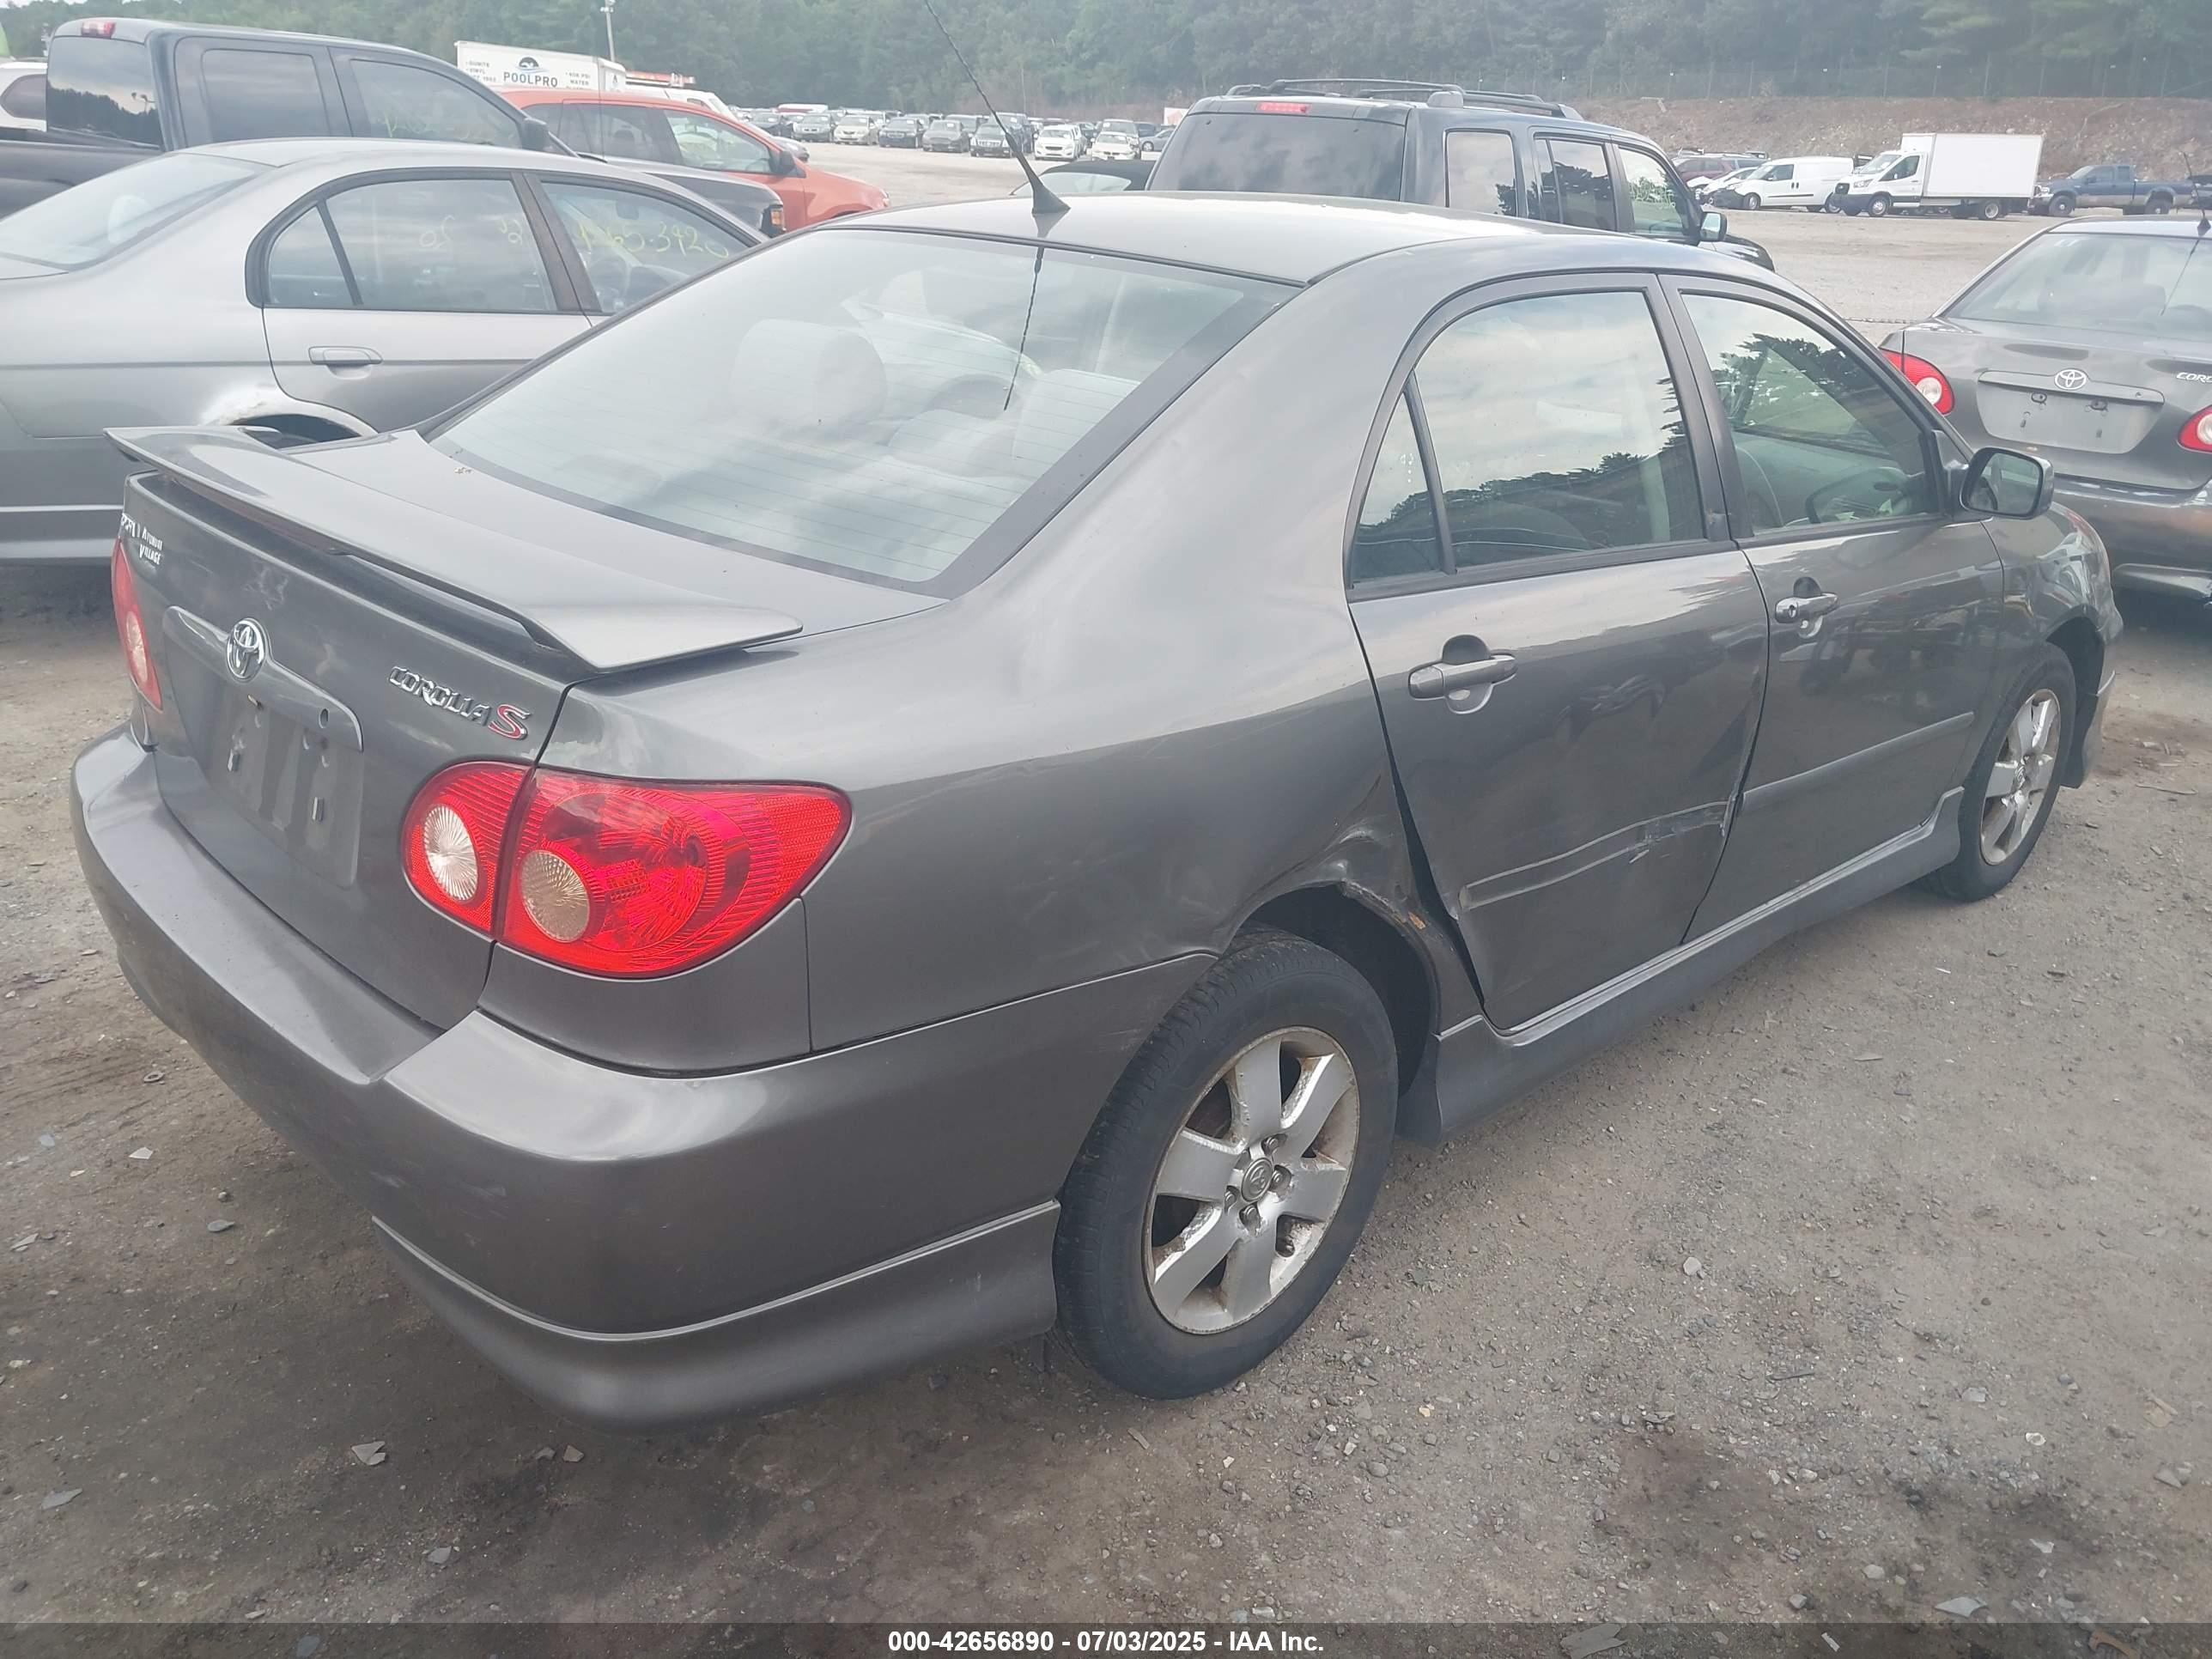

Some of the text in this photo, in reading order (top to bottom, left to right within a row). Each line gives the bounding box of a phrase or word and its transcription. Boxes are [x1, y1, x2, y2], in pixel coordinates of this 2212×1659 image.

[503, 71, 558, 88] POOLPRO
[387, 665, 534, 741] COROLLA S
